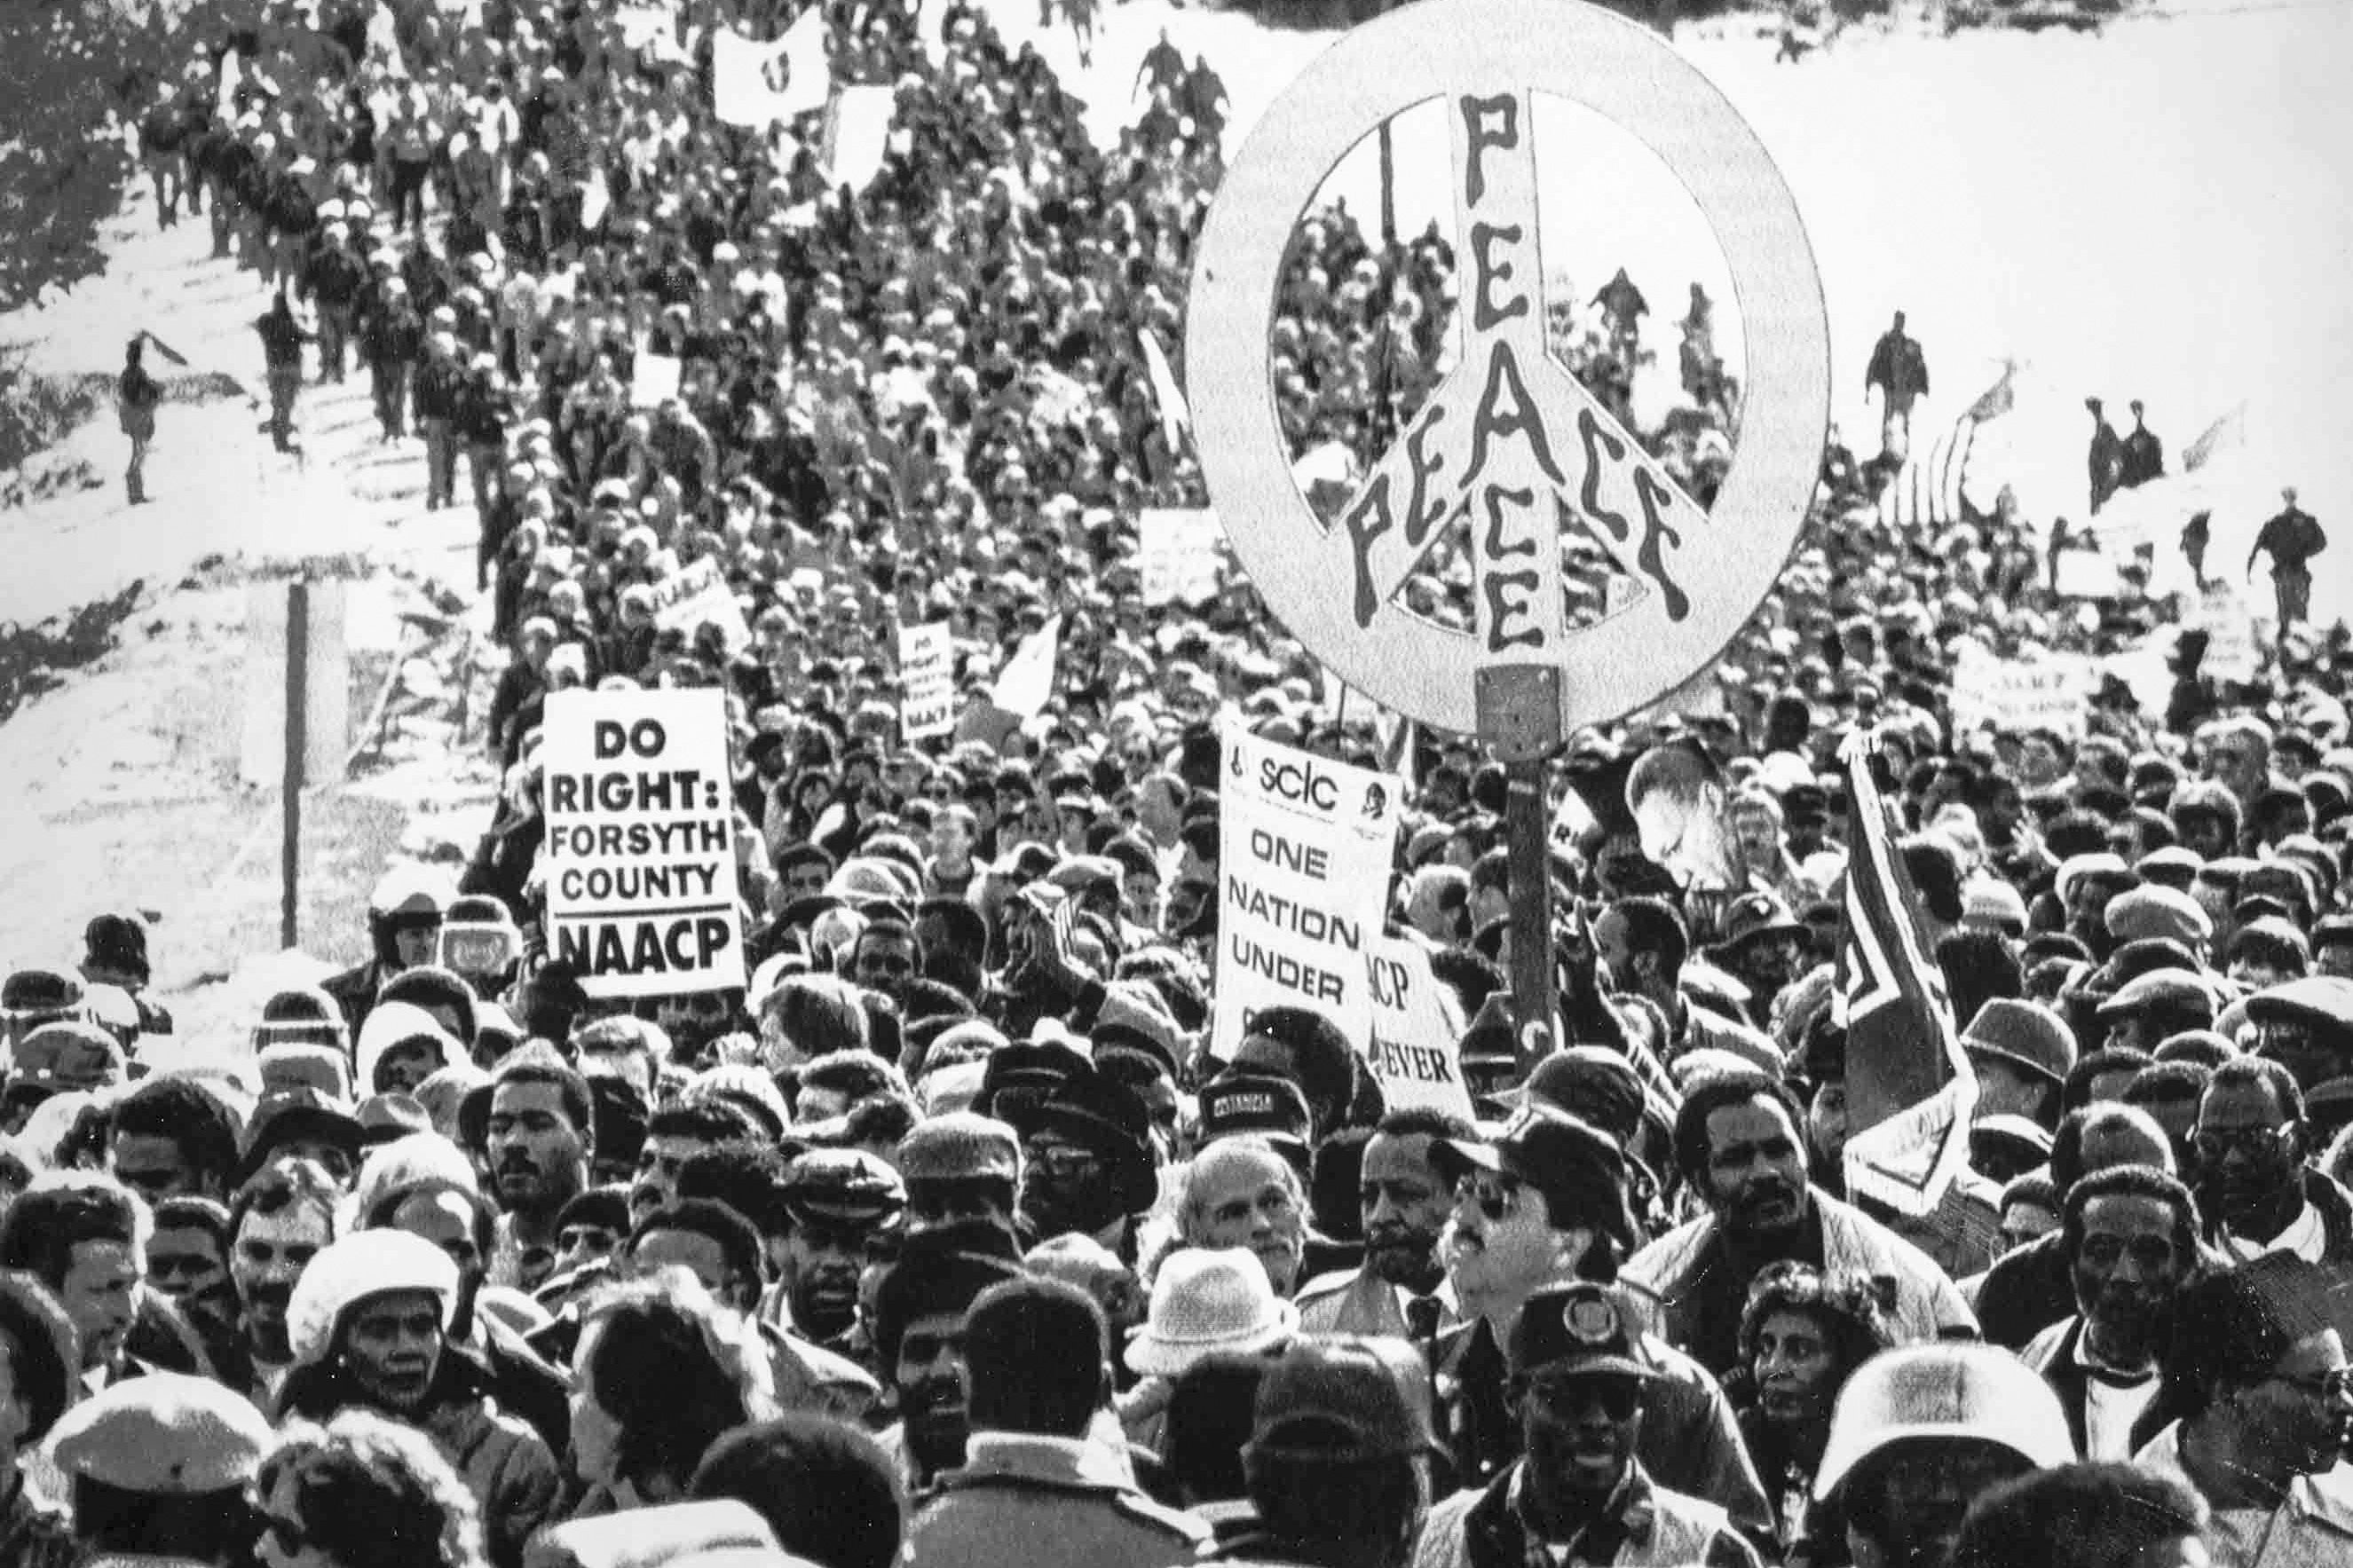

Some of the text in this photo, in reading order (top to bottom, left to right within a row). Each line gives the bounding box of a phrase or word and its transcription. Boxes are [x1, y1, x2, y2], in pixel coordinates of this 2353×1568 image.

[594, 718, 667, 760] DO
[550, 769, 720, 813] RIGHT:
[550, 819, 728, 858] FORSYTH
[1252, 827, 1329, 880] ONE
[560, 862, 720, 901] COUNTY
[1228, 873, 1360, 951] NATION
[558, 917, 730, 976] NAACP
[1233, 932, 1345, 1005] UNDER
[1376, 1039, 1454, 1083] EVER
